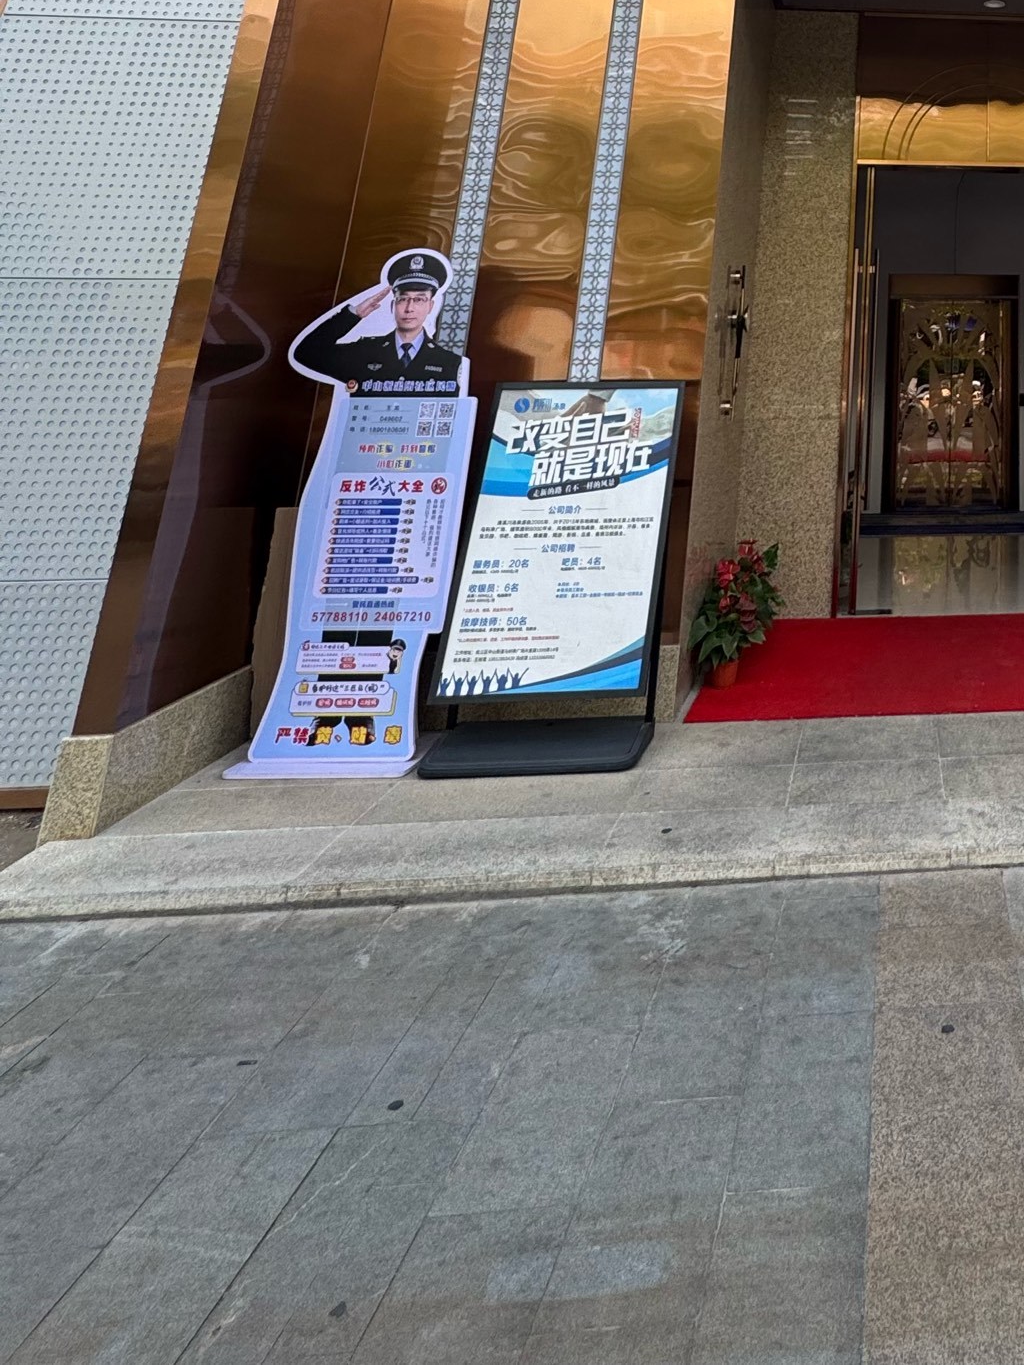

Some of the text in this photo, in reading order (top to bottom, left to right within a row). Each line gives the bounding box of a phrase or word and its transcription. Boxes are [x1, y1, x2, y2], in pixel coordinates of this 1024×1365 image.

[505, 407, 633, 455] 改变自己
[528, 439, 653, 486] 就是现在
[340, 476, 424, 496] 反诈公式大全
[548, 505, 582, 515] 公司简介
[541, 543, 576, 553] 公司招聘
[311, 611, 431, 622] 57788110 24067210
